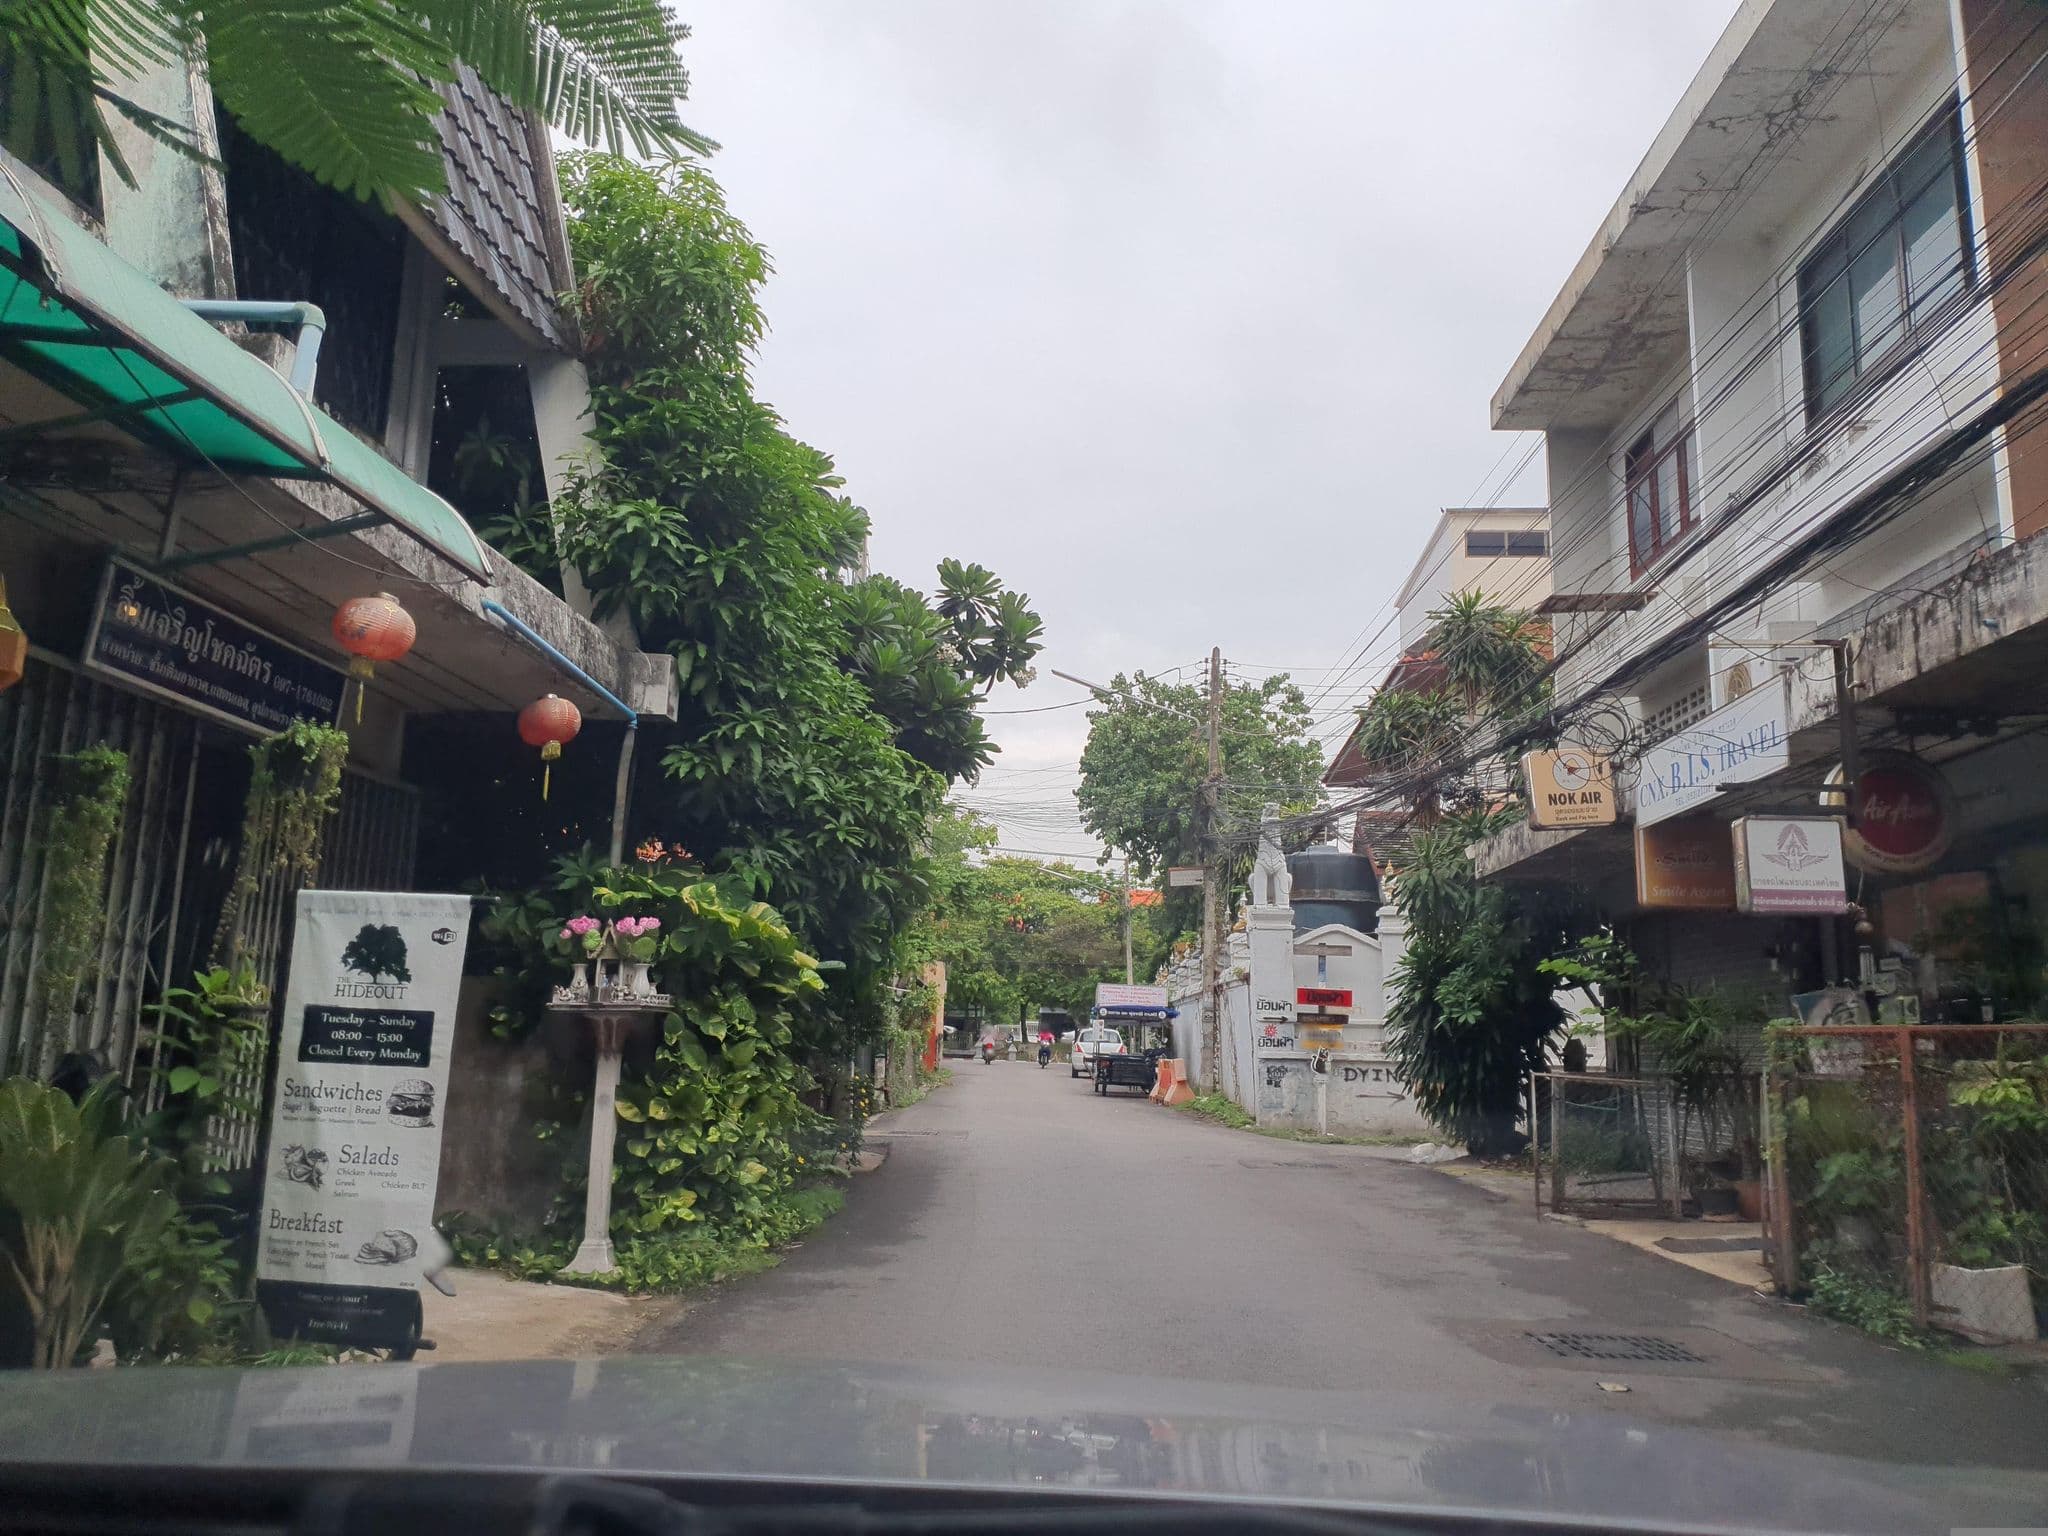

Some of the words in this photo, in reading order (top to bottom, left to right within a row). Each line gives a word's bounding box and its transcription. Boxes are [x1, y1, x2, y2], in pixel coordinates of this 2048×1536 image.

[1717, 720, 1782, 772] TRAVEL
[1548, 793, 1577, 806] NOK
[1580, 791, 1603, 804] AIR
[334, 983, 408, 1000] HIDEOUT
[1256, 998, 1292, 1011] ย้อมผ้า
[322, 1012, 365, 1026] Tuesday
[379, 1016, 417, 1030] Sunday
[331, 1030, 362, 1041] 08:00
[376, 1032, 403, 1043] 15:00
[1257, 1036, 1294, 1050] ย้อมผ้า
[308, 1044, 343, 1056] Closed
[346, 1046, 376, 1060] Every
[379, 1048, 421, 1062] Monday
[284, 1078, 383, 1101] Sandwiches
[354, 1104, 381, 1115] Bread
[339, 1144, 399, 1166] Salads
[337, 1168, 365, 1176] Chicken
[381, 1181, 409, 1189] Chicken
[270, 1208, 344, 1234] Breakfast
